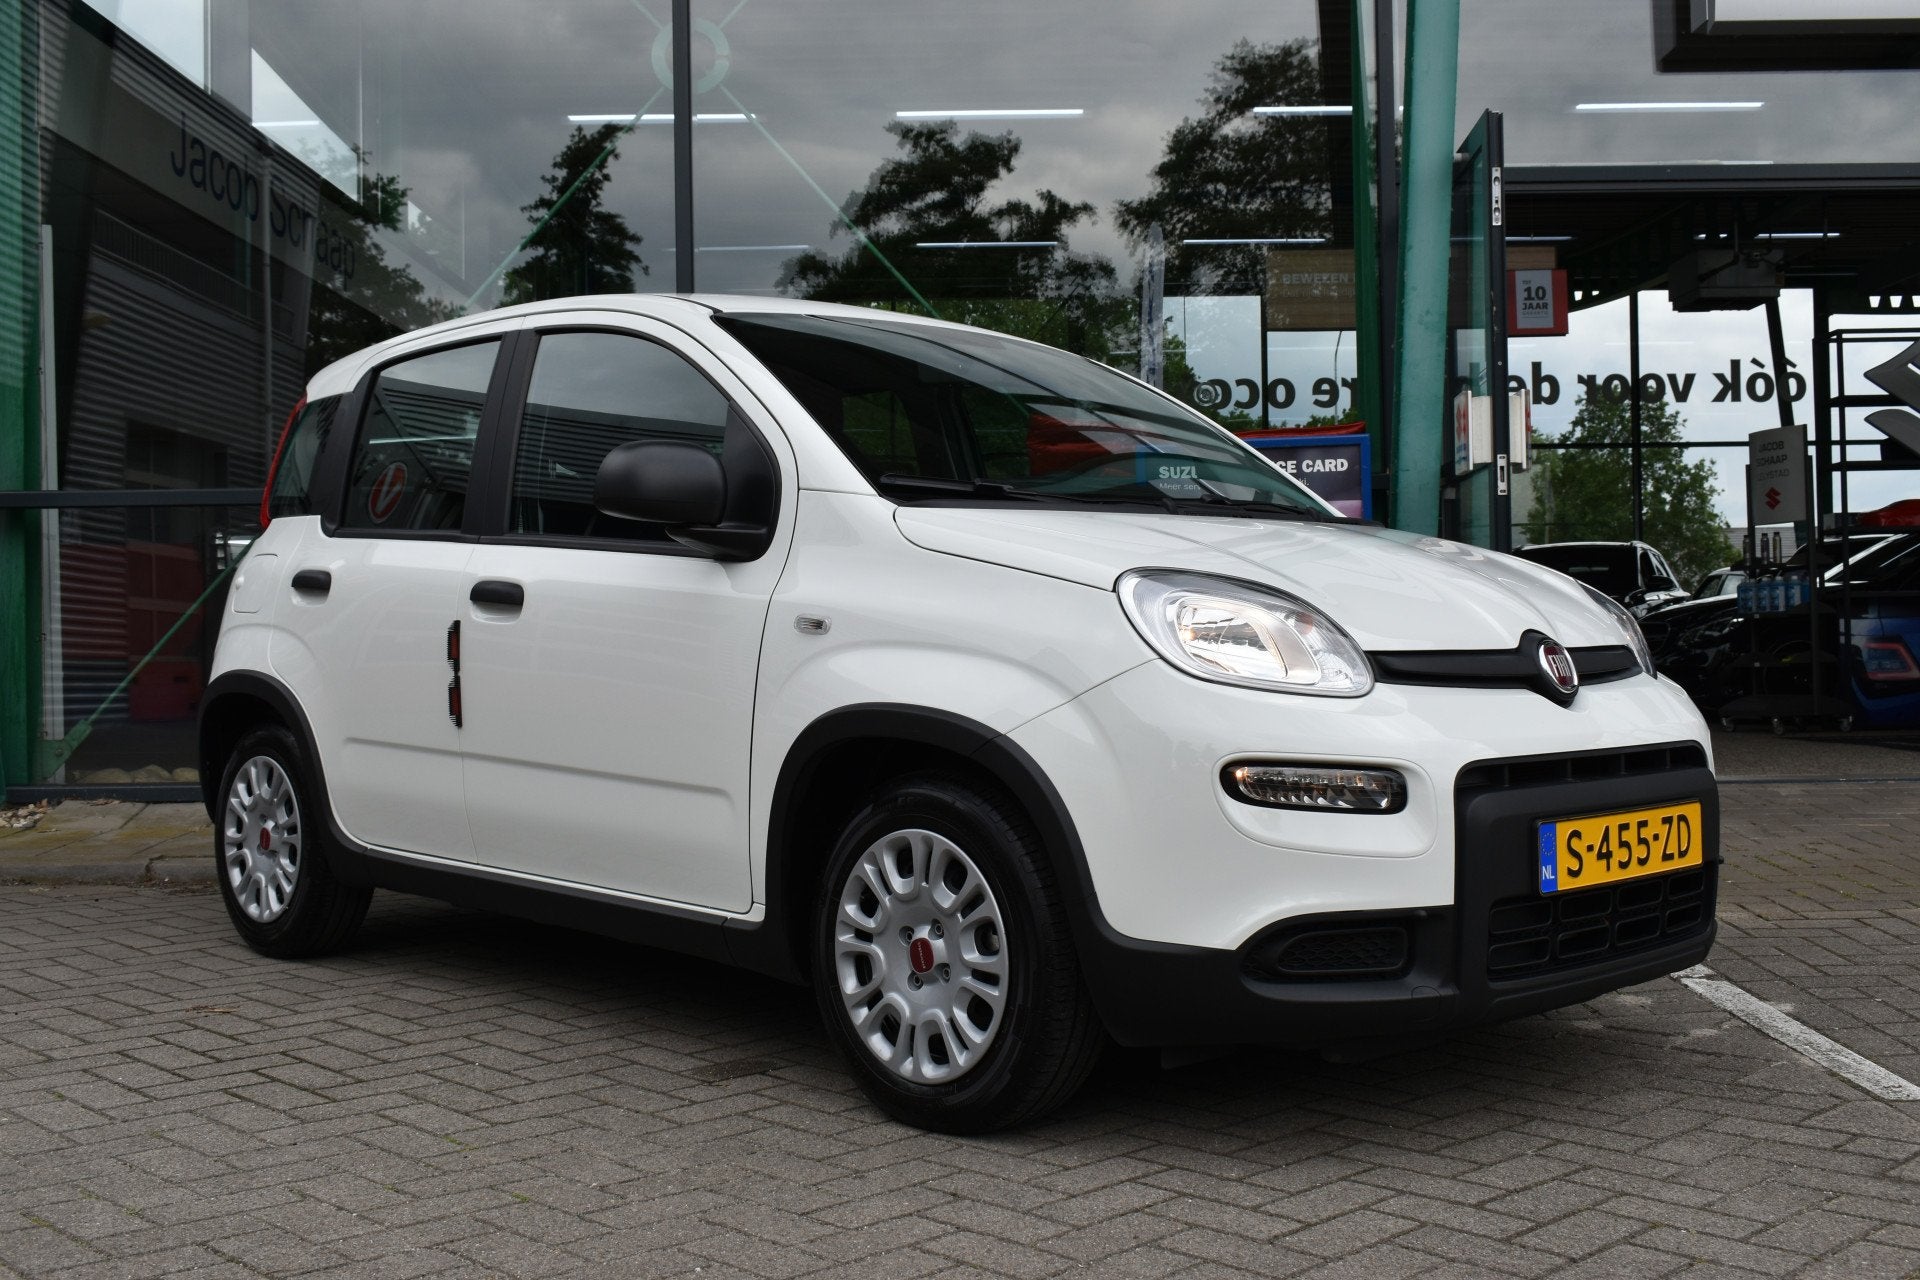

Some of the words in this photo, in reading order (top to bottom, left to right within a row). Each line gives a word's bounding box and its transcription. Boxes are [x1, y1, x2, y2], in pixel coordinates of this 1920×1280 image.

[171, 111, 260, 222] Jacob
[1523, 285, 1547, 301] 10
[1522, 302, 1549, 311] JAAR
[1758, 441, 1785, 454] JACOB
[1276, 460, 1297, 474] CE
[1302, 458, 1349, 473] CARD
[1756, 454, 1788, 468] SCHAAP
[1159, 482, 1182, 491] Meer
[1547, 654, 1572, 678] FIAT
[1567, 813, 1691, 878] S-455-ZD
[1542, 865, 1555, 881] NL
